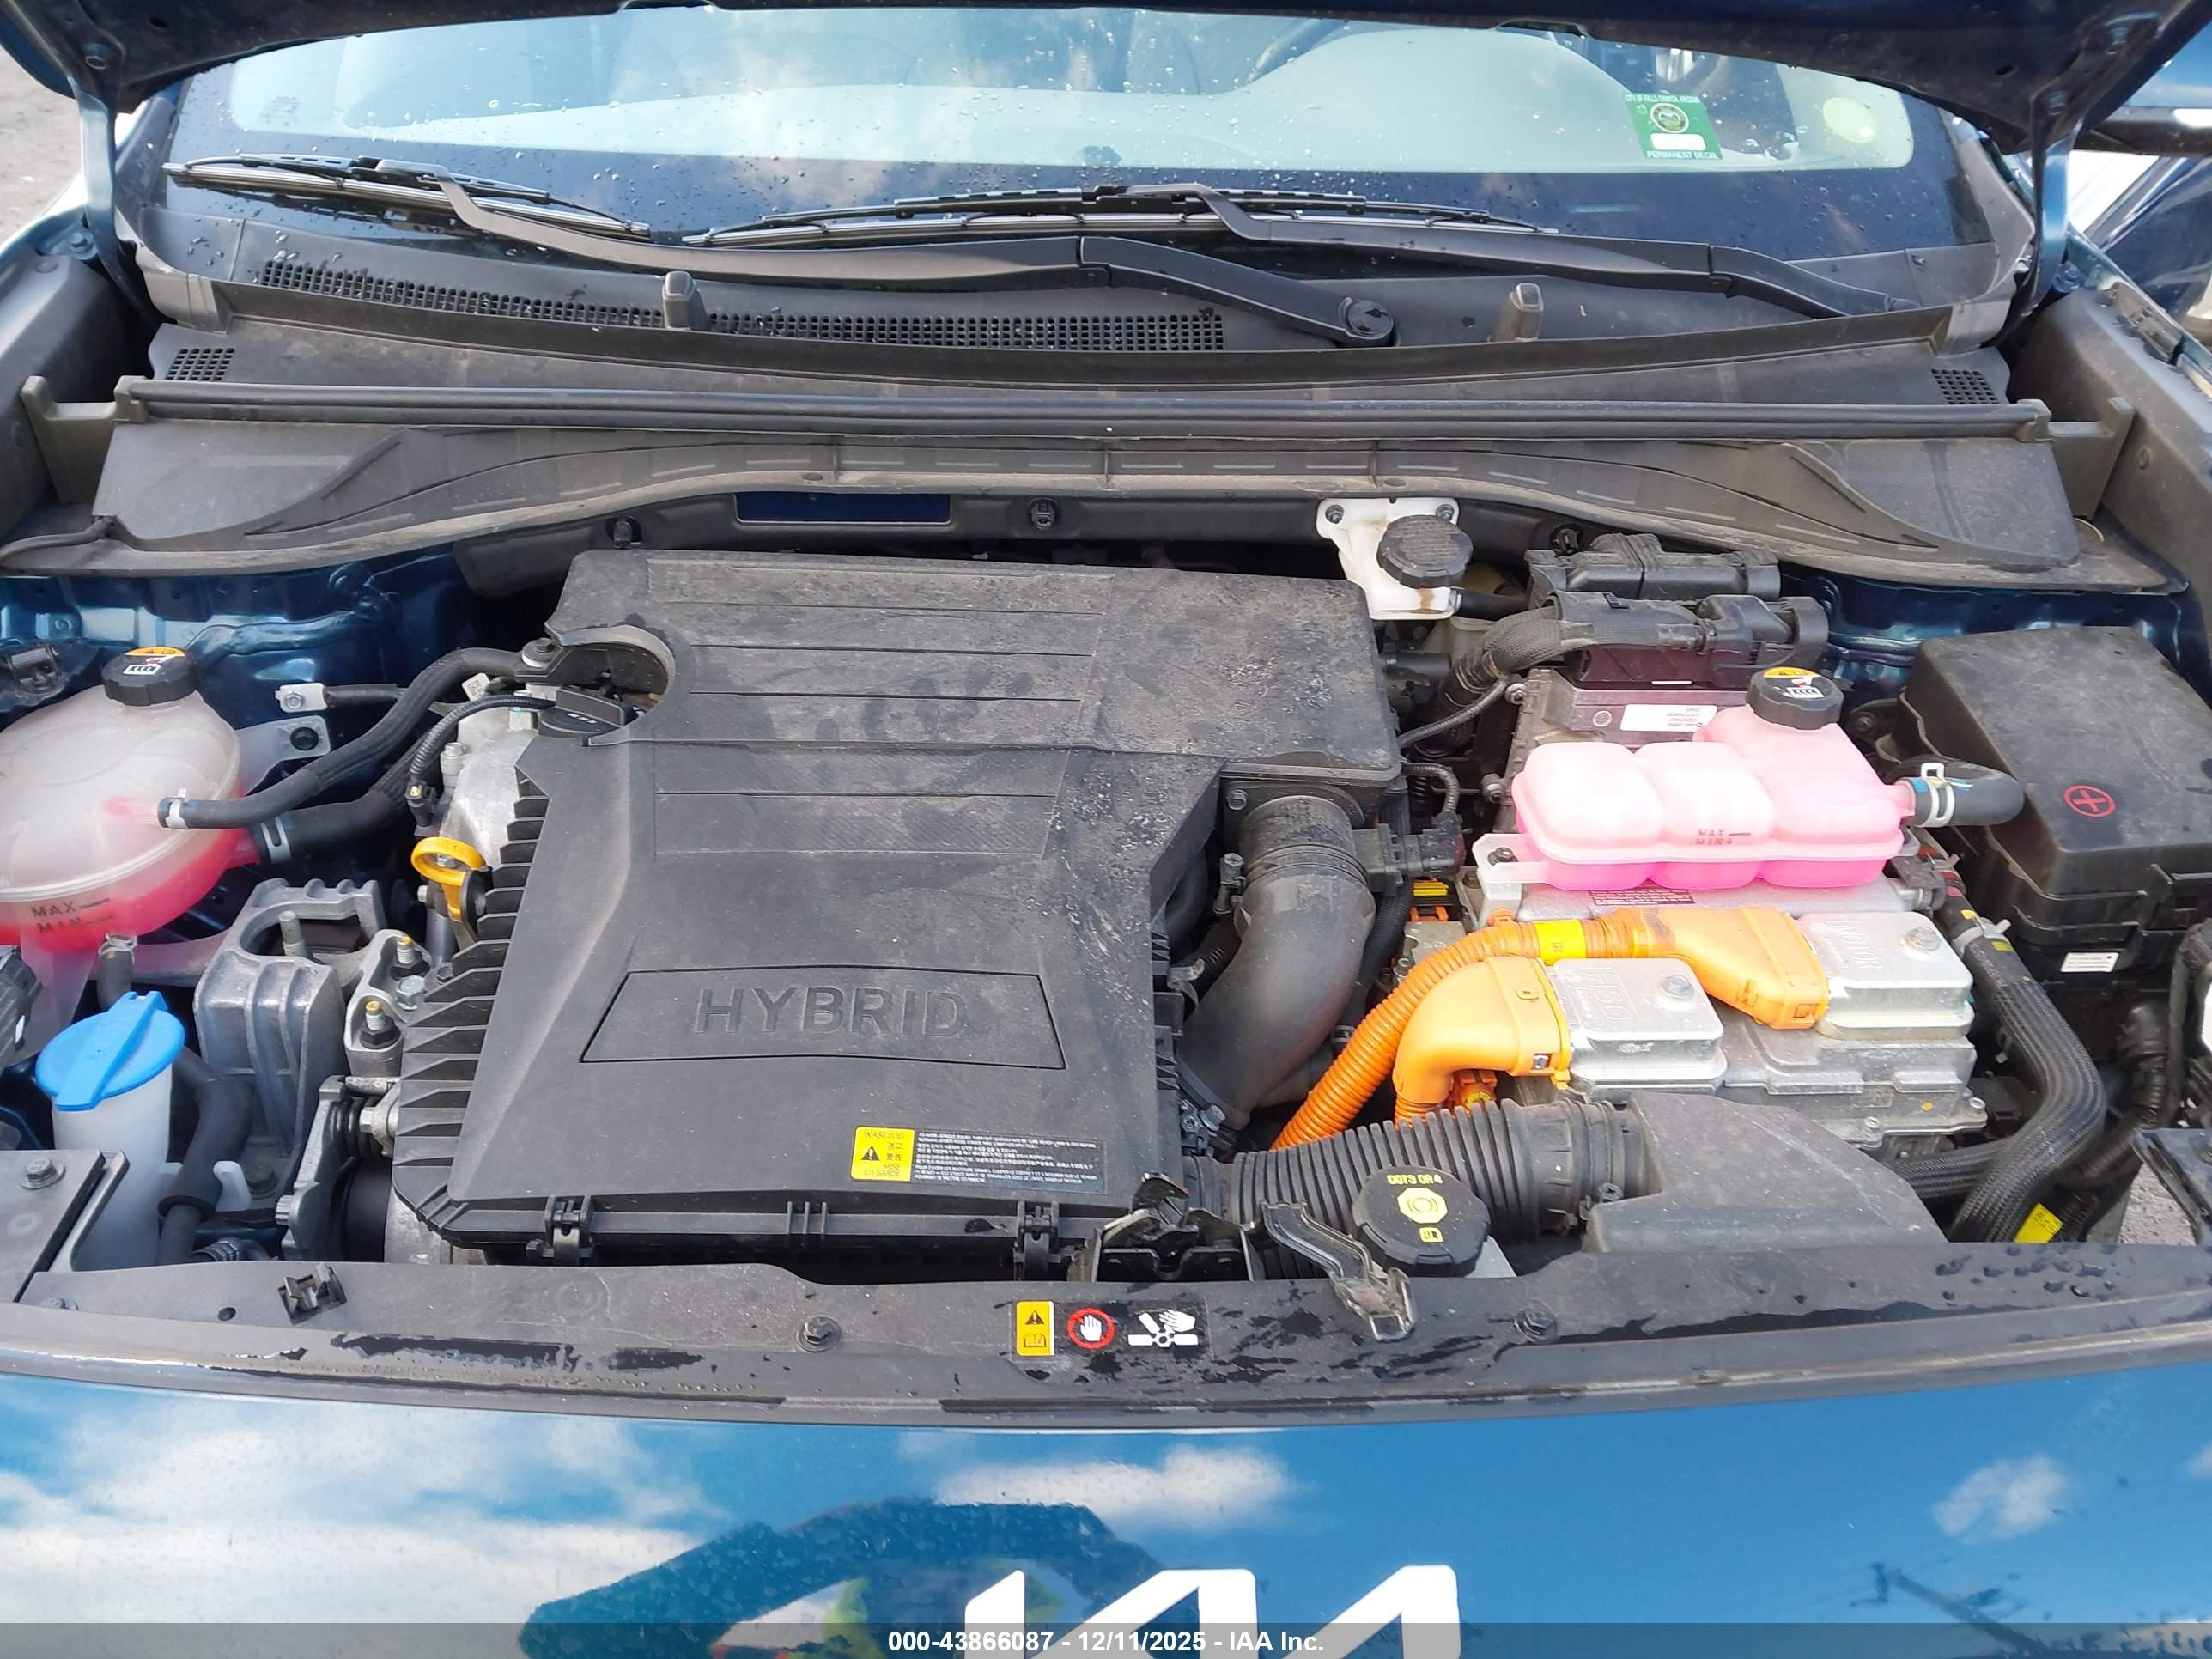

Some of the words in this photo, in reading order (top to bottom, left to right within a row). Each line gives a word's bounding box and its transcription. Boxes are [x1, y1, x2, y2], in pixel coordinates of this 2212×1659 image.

[31, 901, 76, 917] MAX
[37, 916, 82, 933] MIN
[694, 987, 968, 1037] HYBRID
[1418, 1175, 1434, 1185] OR
